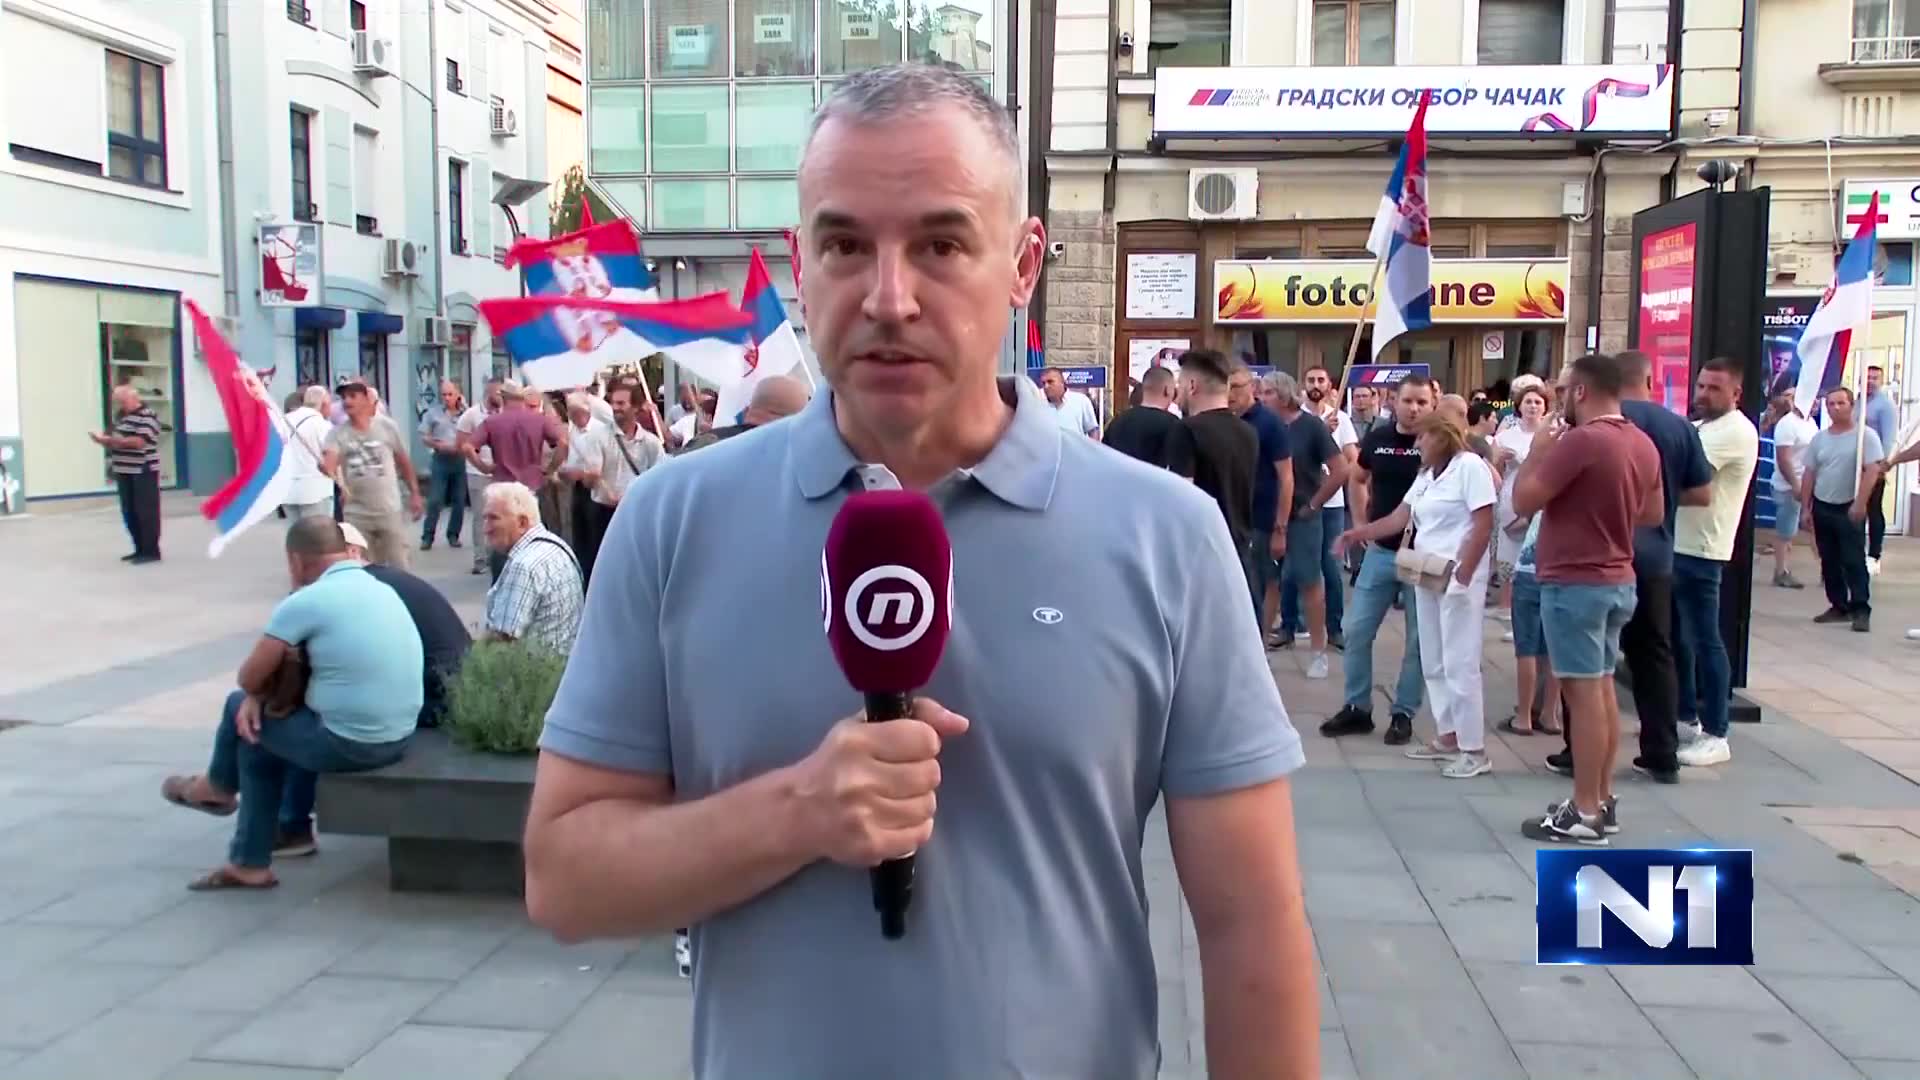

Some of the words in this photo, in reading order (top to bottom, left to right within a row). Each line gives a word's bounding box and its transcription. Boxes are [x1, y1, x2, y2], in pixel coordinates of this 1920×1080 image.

[1276, 88, 1385, 110] ГРАДСКИ
[1484, 88, 1566, 106] ЧАЧАК
[1763, 315, 1809, 325] TISSOT
[1374, 447, 1396, 455] JACK
